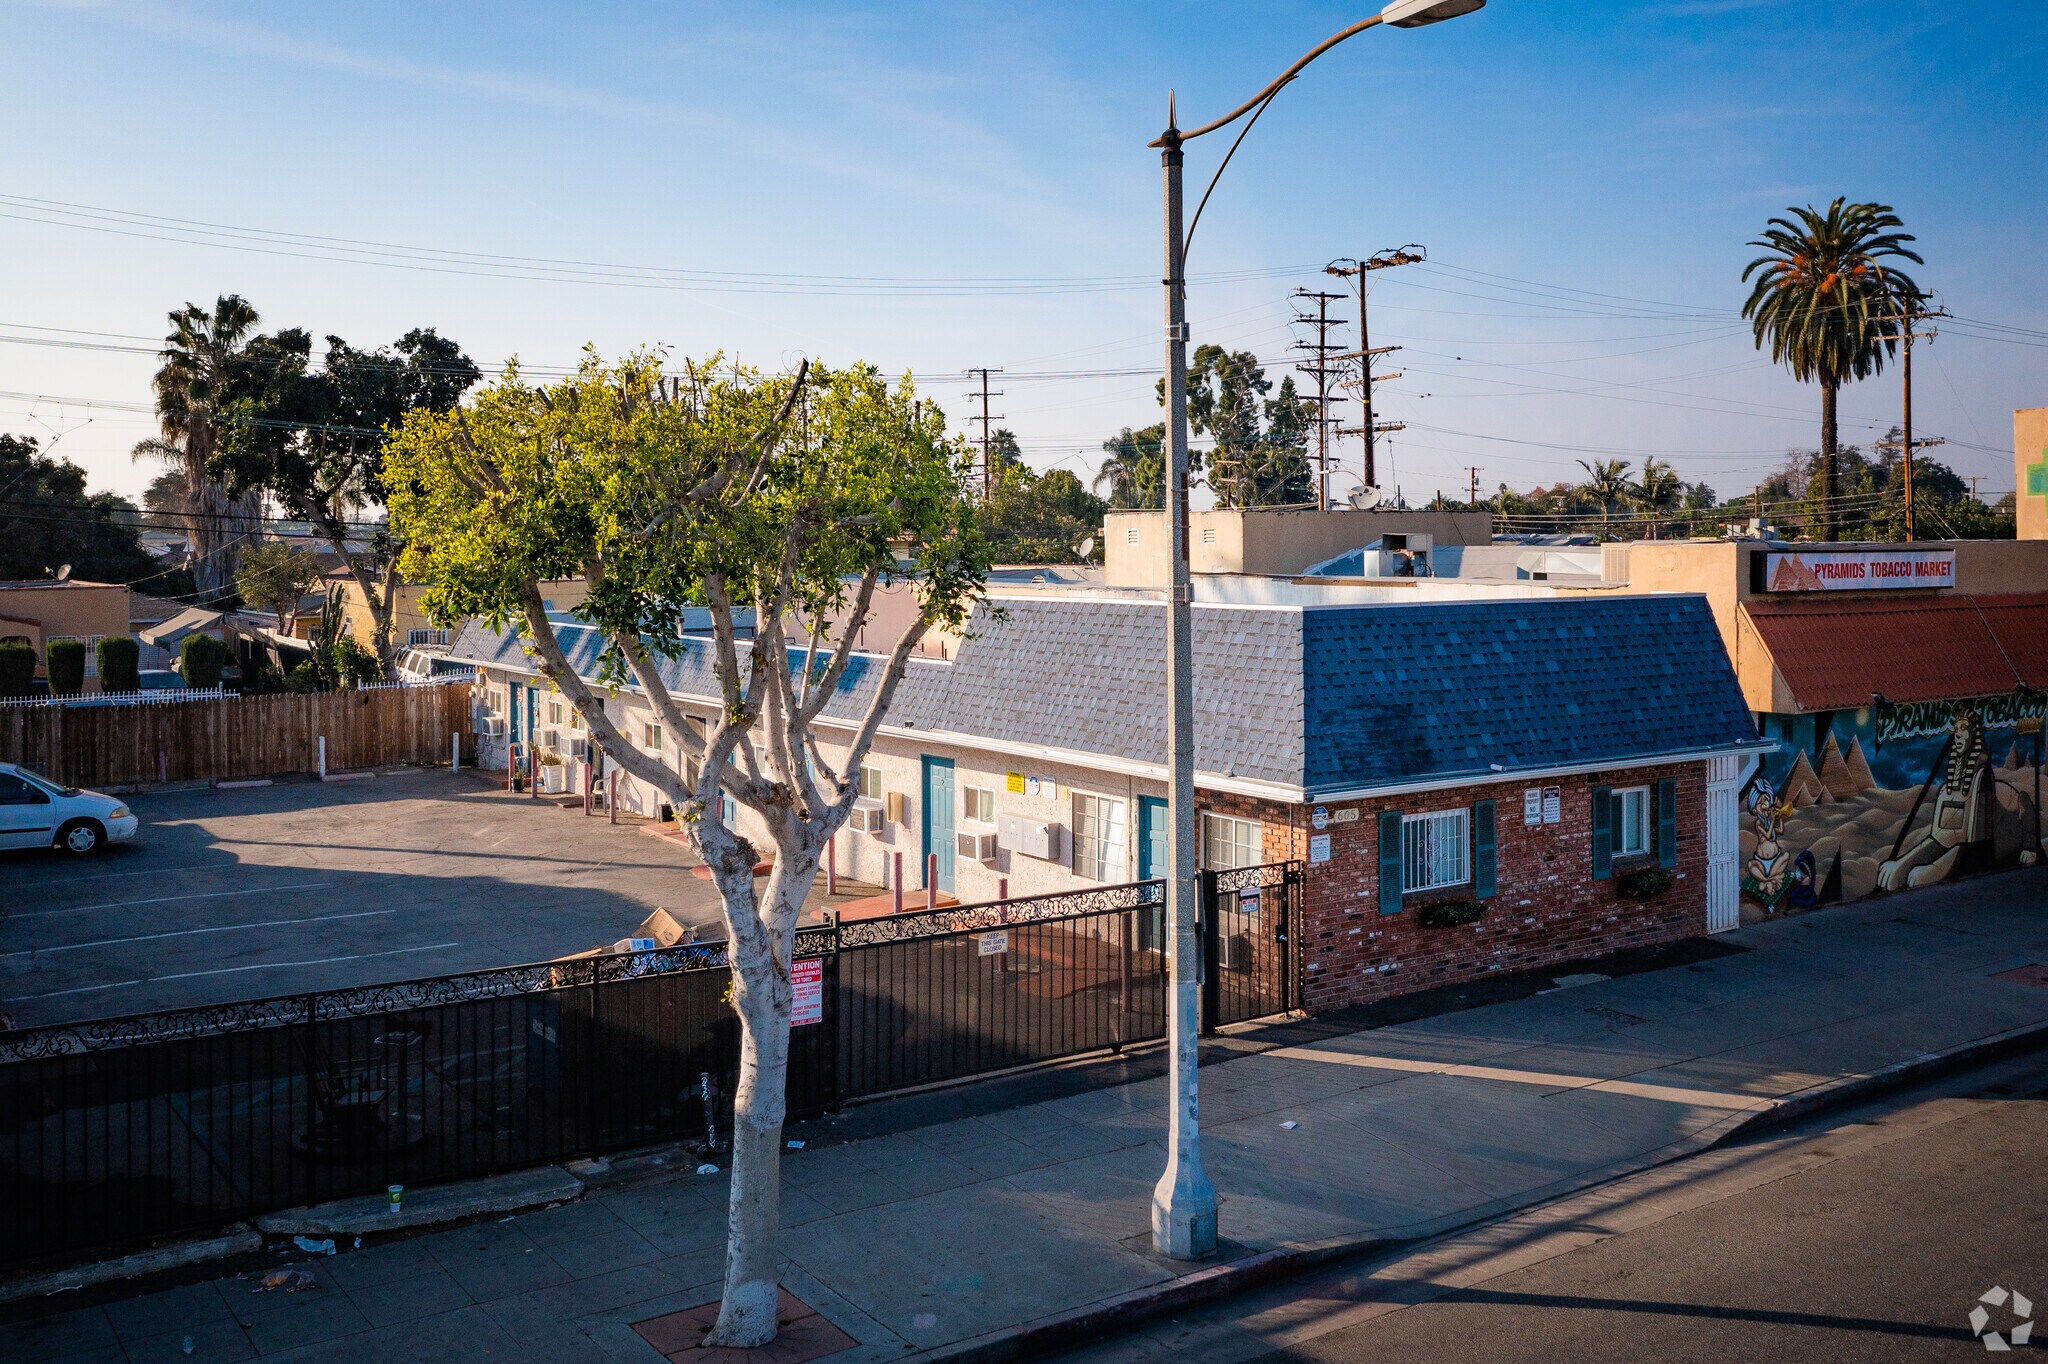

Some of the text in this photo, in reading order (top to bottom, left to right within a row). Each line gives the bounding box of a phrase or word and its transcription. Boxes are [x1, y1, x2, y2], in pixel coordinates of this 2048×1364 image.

[1814, 561, 1952, 579] PYRAMIDS TOBACCO MARKET
[1337, 810, 1357, 820] 605
[791, 961, 820, 972] TENTION
